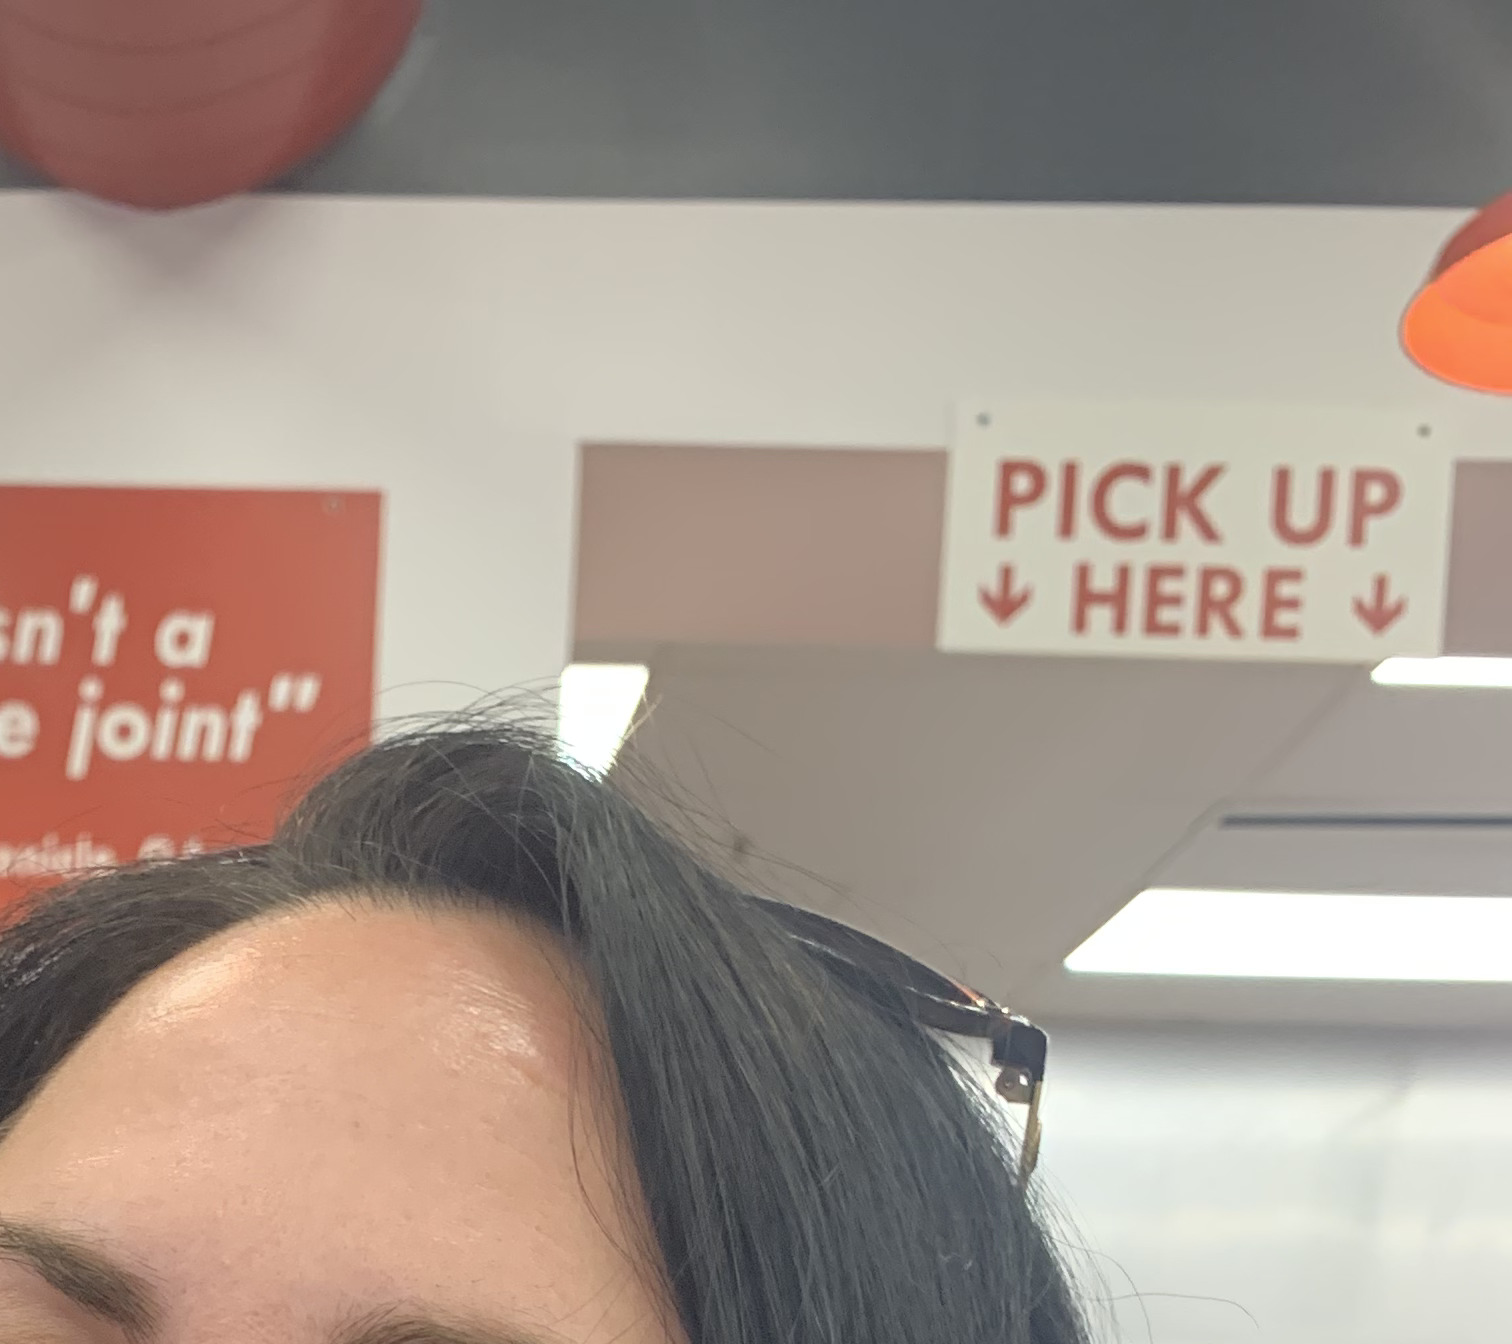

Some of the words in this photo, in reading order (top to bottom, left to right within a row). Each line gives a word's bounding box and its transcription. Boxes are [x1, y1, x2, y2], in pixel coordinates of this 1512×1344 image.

[992, 458, 1227, 545] PICK
[1269, 466, 1405, 548] UP
[154, 610, 214, 667] a
[1069, 561, 1304, 640] HERE
[64, 673, 320, 779] joint"
